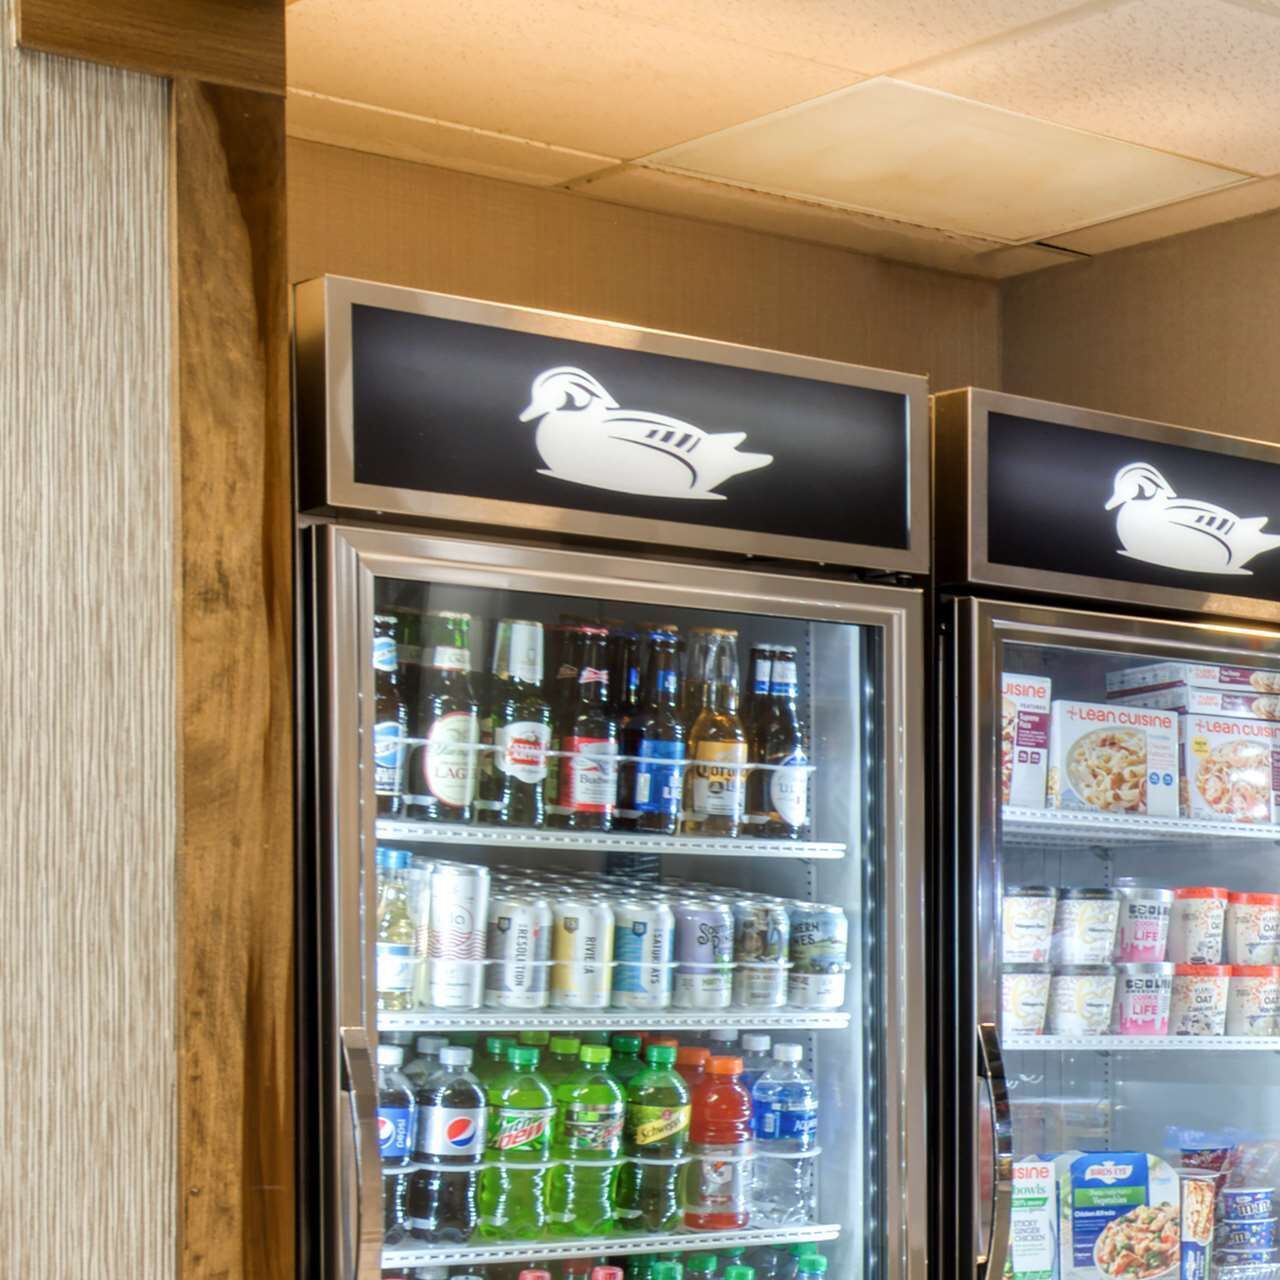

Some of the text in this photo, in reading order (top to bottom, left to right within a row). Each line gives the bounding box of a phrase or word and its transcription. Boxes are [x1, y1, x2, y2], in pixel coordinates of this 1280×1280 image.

[1262, 923, 1280, 933] OAT
[1134, 931, 1160, 942] LIFE
[1194, 995, 1213, 1004] OAT
[1262, 995, 1280, 1005] OAT
[1132, 1004, 1159, 1016] LIFE
[396, 1119, 407, 1149] pepsi
